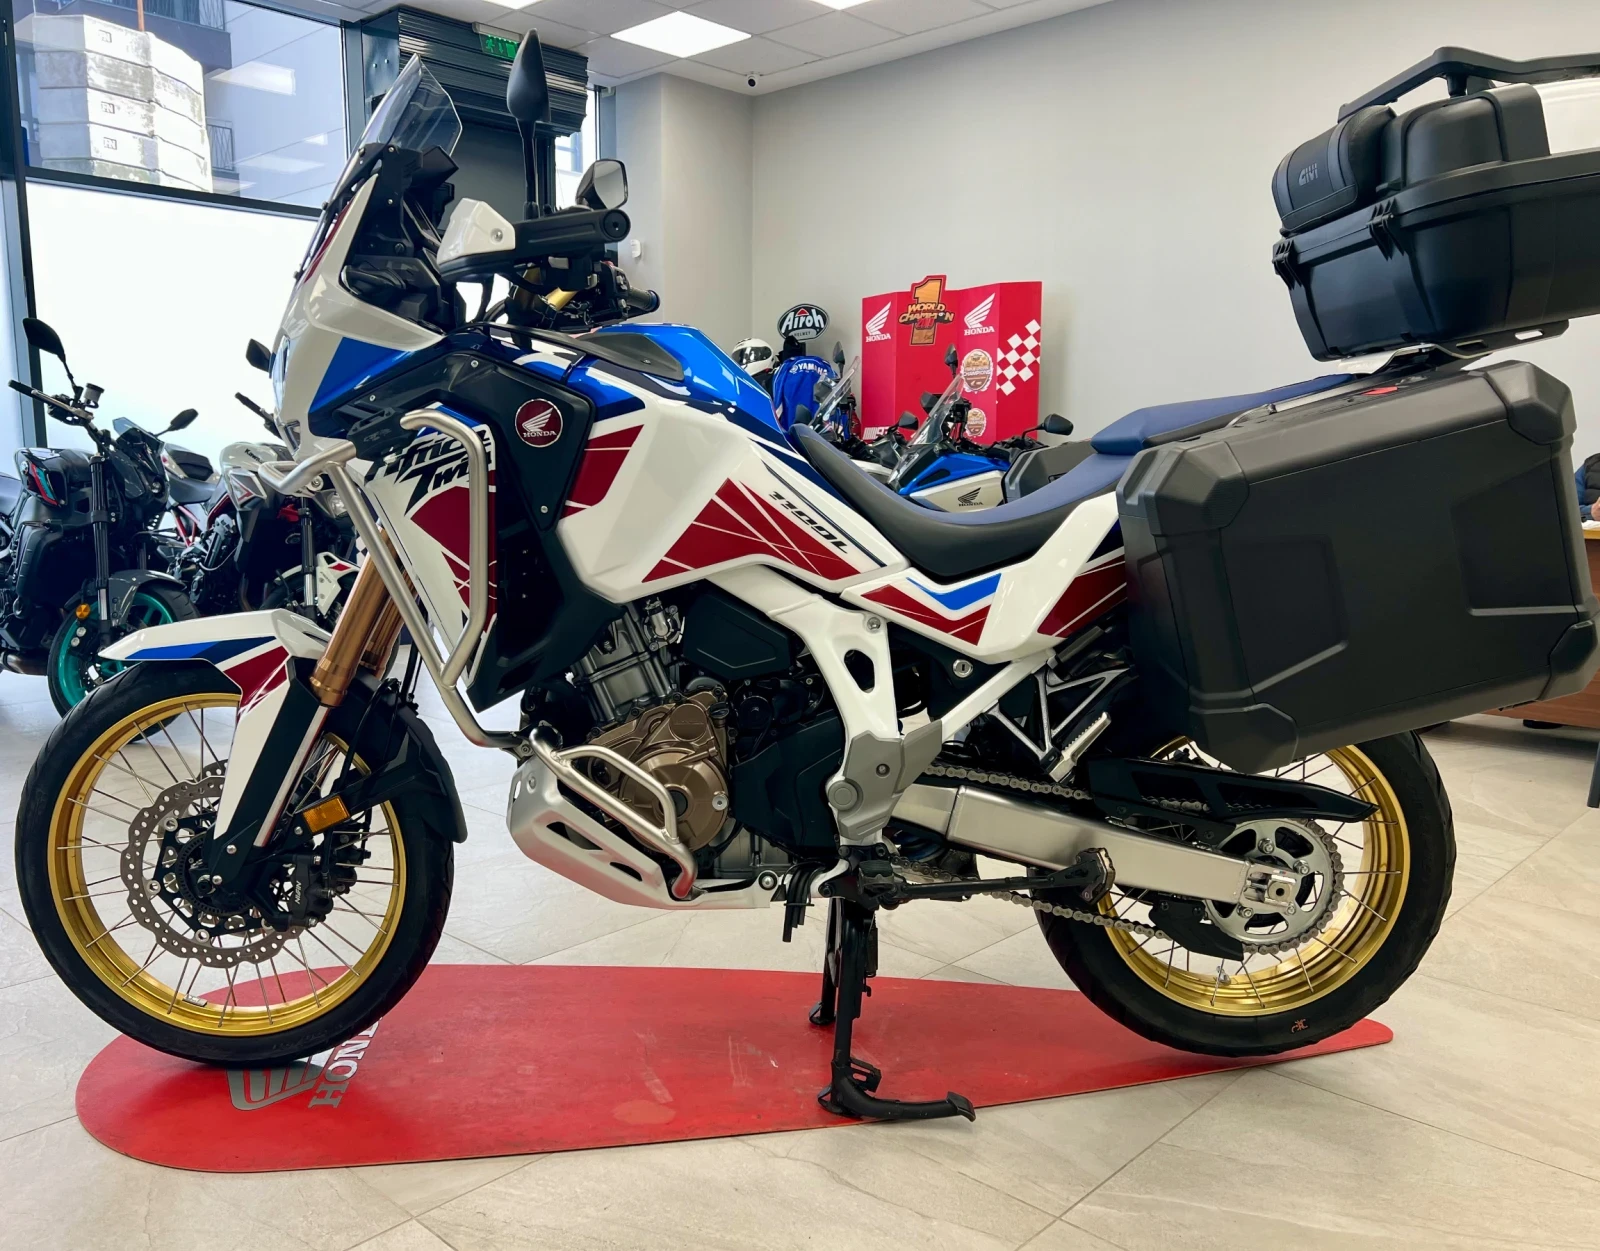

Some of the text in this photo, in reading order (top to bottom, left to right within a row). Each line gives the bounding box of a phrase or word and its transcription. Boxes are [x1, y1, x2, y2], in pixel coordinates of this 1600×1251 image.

[908, 303, 946, 313] WORLD
[781, 308, 825, 334] Airoh
[964, 326, 995, 336] HONDA
[865, 333, 891, 343] HONDA
[522, 430, 557, 438] HONDA
[308, 1016, 383, 1109] HON
